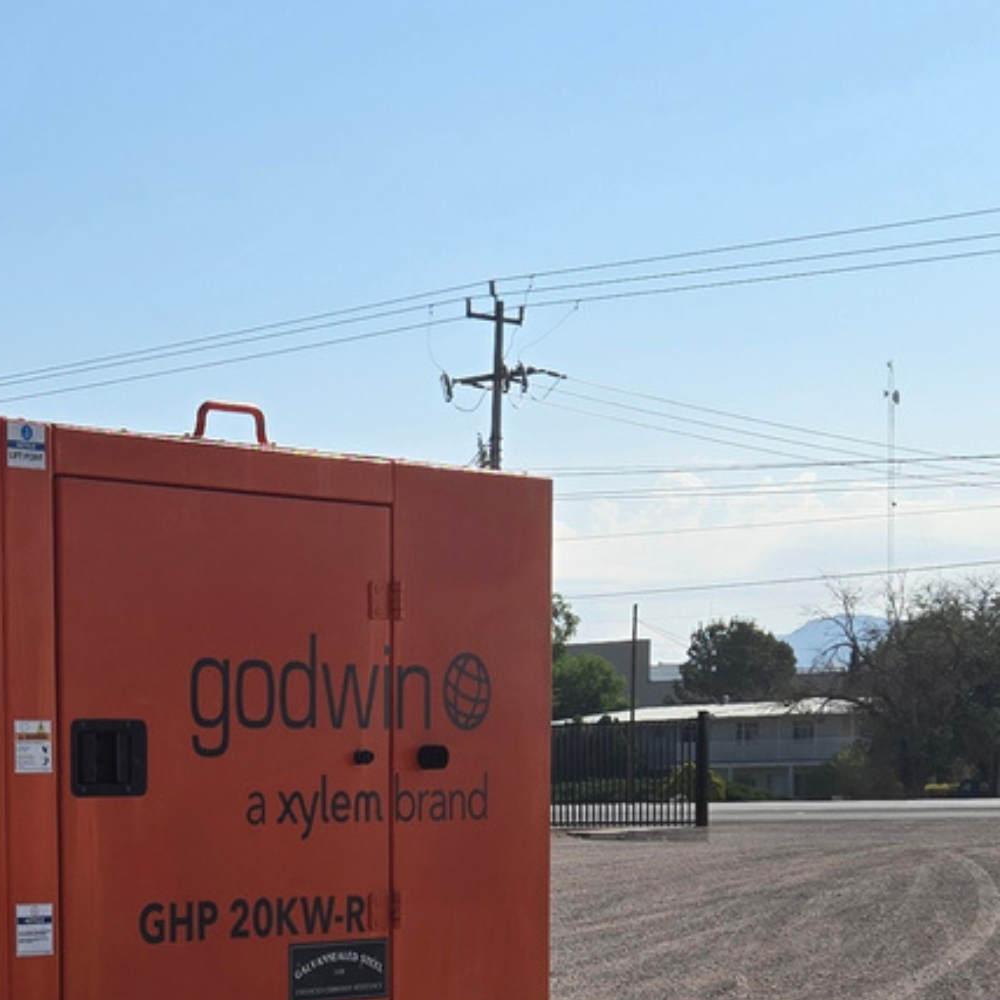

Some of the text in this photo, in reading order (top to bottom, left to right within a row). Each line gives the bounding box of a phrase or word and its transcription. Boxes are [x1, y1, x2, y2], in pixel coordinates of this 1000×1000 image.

[189, 633, 431, 758] godwin
[246, 771, 488, 841] a xylem brand
[138, 895, 366, 945] GHP 20KW-R
